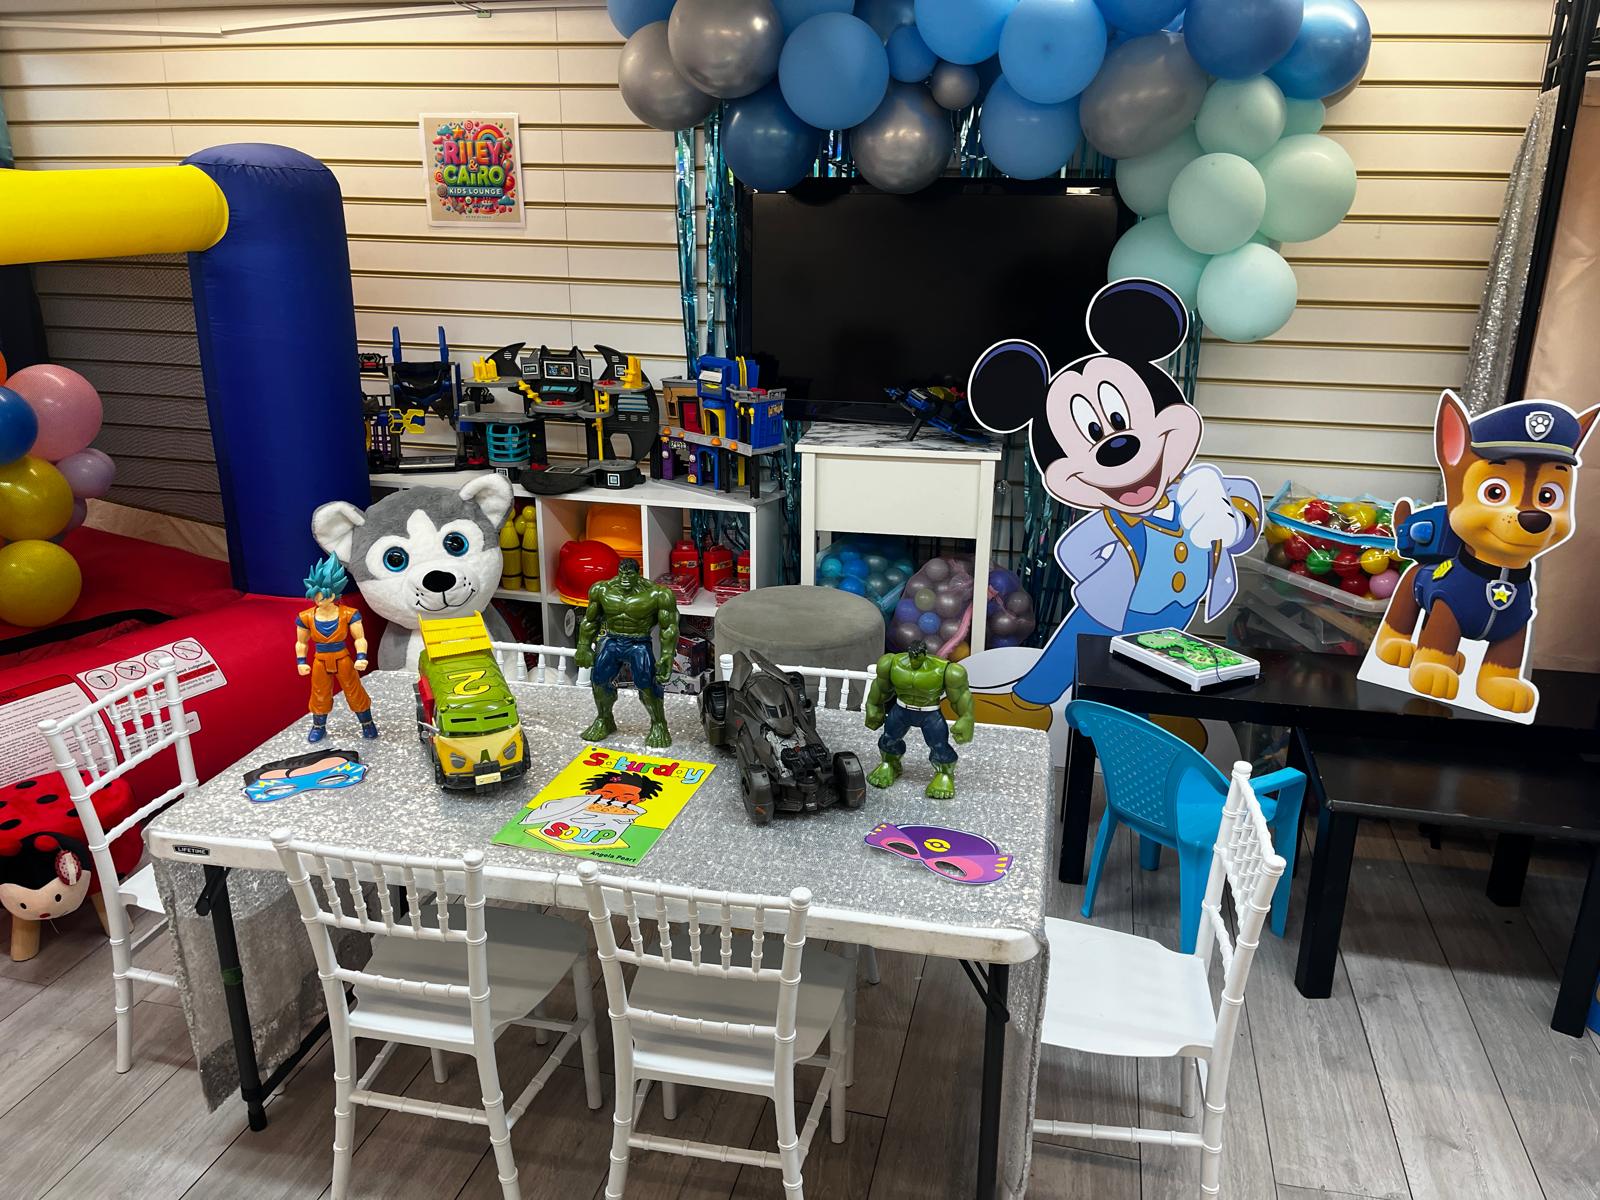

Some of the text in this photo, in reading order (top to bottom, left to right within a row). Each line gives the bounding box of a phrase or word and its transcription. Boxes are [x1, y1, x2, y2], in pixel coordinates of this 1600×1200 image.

[444, 140, 501, 165] RILEY
[469, 158, 479, 172] &
[583, 752, 705, 785] Saturday
[177, 847, 206, 855] LIFETIME
[589, 851, 637, 864] Angela Peart
